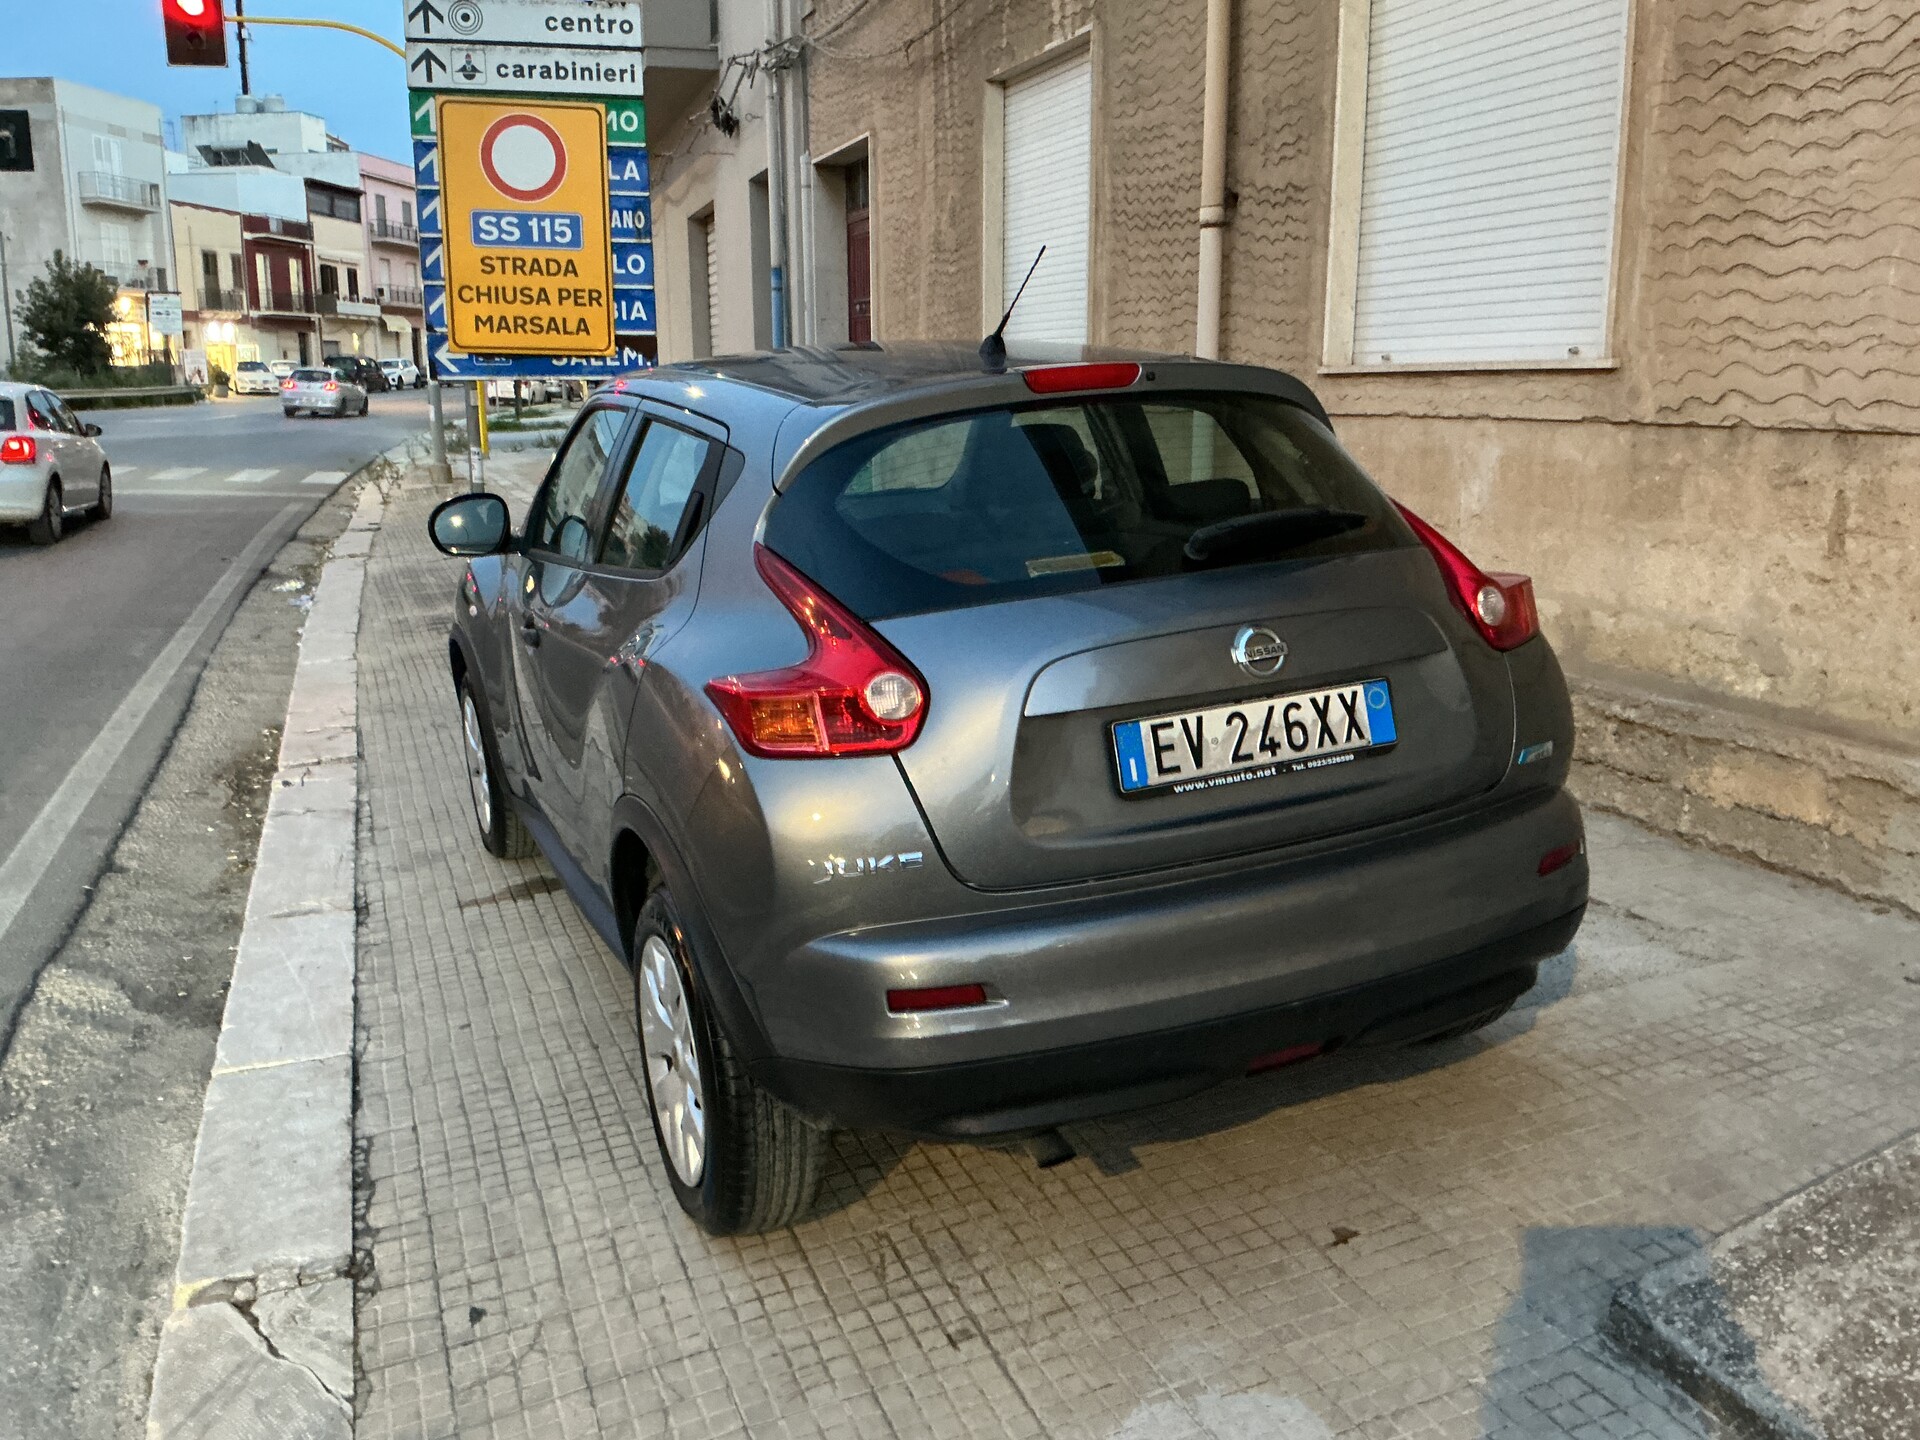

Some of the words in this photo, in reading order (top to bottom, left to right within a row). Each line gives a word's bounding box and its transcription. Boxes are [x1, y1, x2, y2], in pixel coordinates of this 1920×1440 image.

[545, 15, 634, 35] centro
[496, 61, 636, 83] carabinieri
[478, 215, 521, 242] SS
[528, 217, 572, 244] 115
[480, 256, 579, 277] STRADA
[612, 253, 646, 275] LO
[457, 285, 550, 306] CHIUSA
[558, 288, 603, 307] PER
[474, 315, 591, 336] MARSALA
[1244, 644, 1285, 659] NISSAN
[1151, 715, 1204, 777] EV
[1226, 691, 1365, 764] 246XX
[1173, 767, 1277, 793] www.vmauto.net
[808, 851, 923, 885] JUKE
